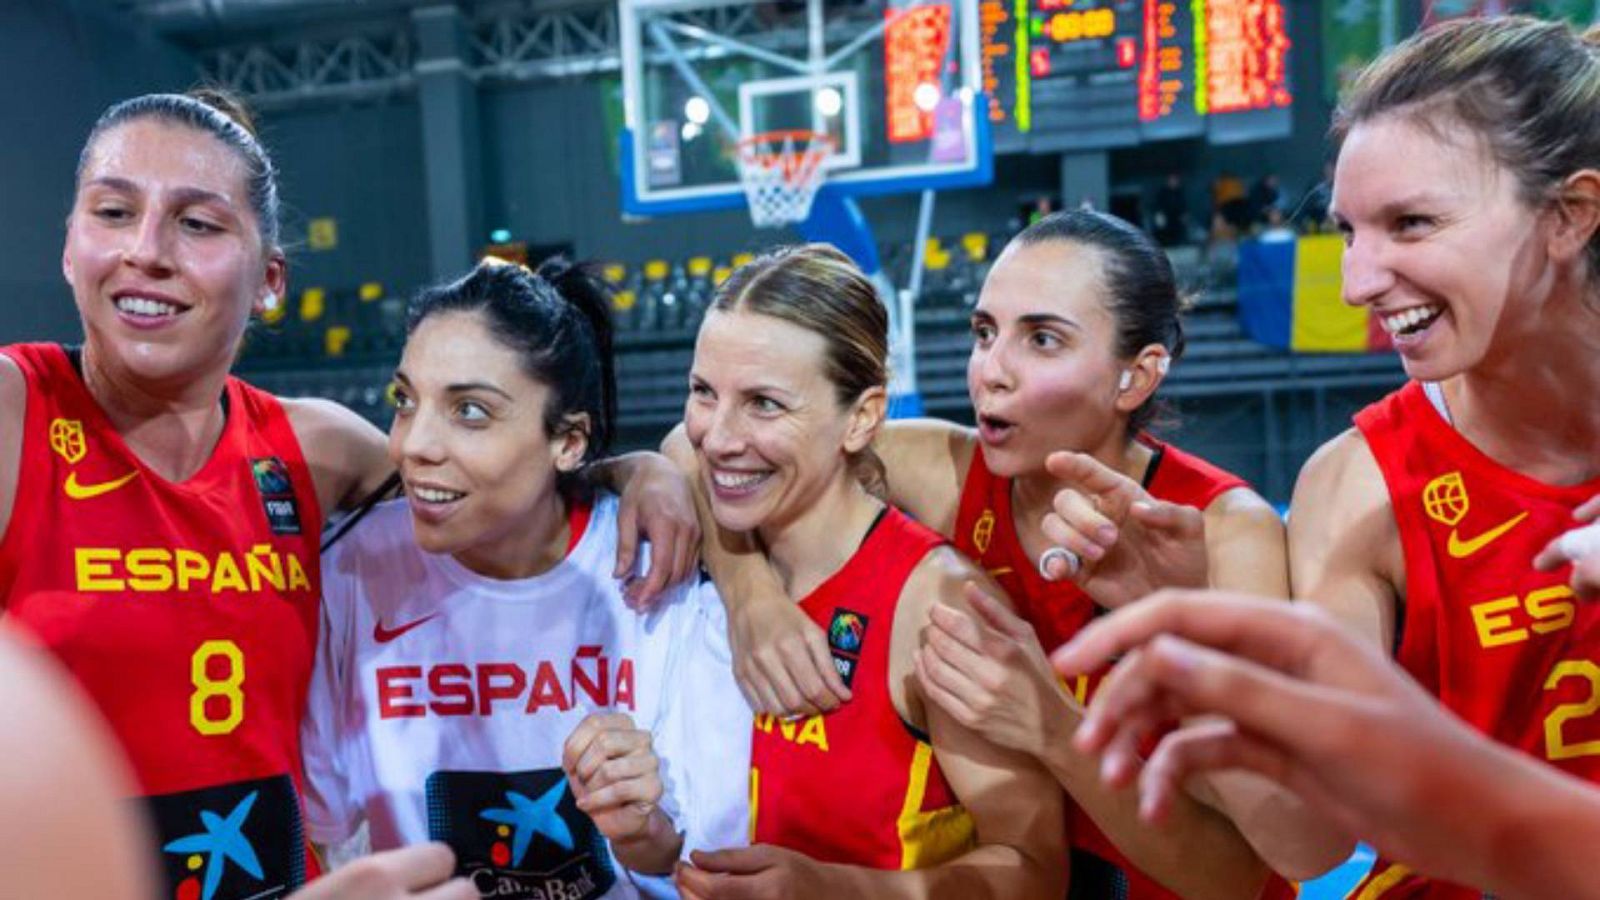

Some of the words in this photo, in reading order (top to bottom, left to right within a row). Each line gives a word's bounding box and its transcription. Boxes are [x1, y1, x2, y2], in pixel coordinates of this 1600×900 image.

[75, 544, 311, 593] ESPAÑA
[190, 639, 246, 736] 8
[376, 645, 636, 719] ESPAÑA
[1543, 659, 1600, 760] 2
